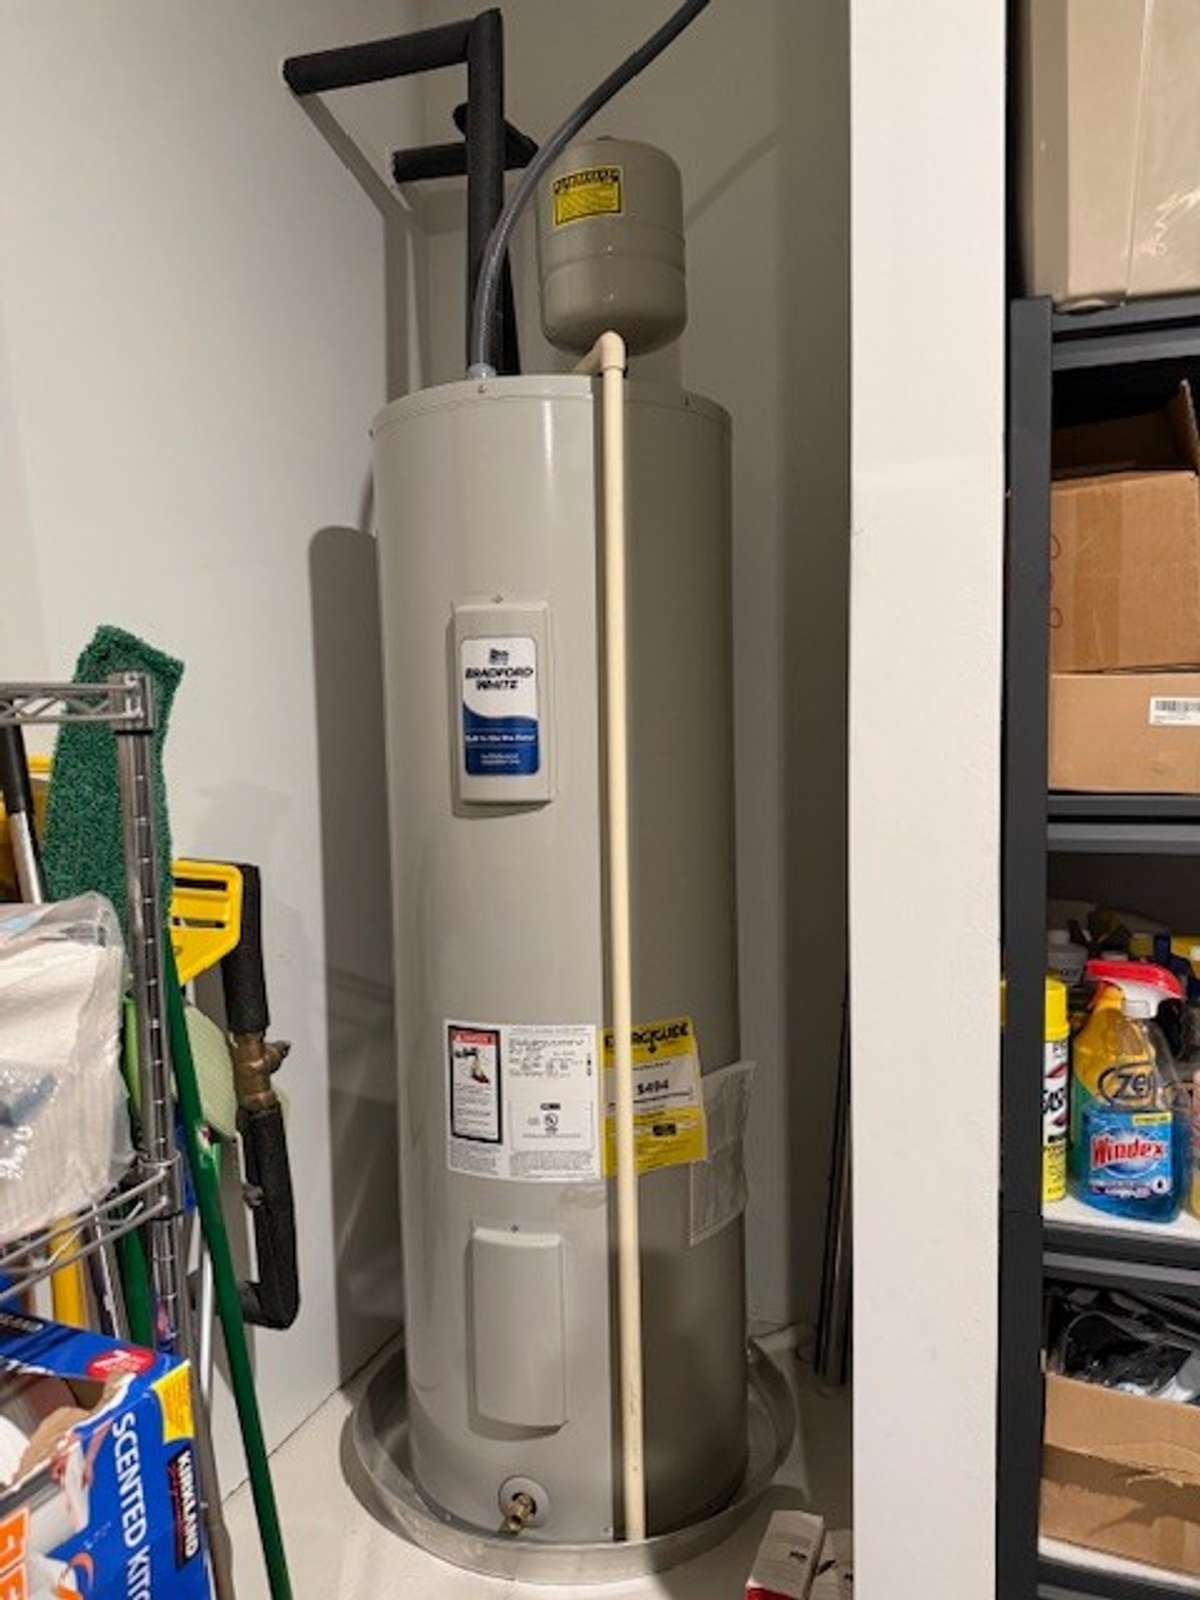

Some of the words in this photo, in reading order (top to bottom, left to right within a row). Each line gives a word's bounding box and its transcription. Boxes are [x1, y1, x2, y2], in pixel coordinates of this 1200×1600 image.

[465, 666, 533, 679] BRADFORD
[476, 679, 517, 691] WHITE
[1092, 1135, 1165, 1167] Windex
[112, 1411, 148, 1548] SCENTED
[177, 1449, 199, 1559] KIRKLAND
